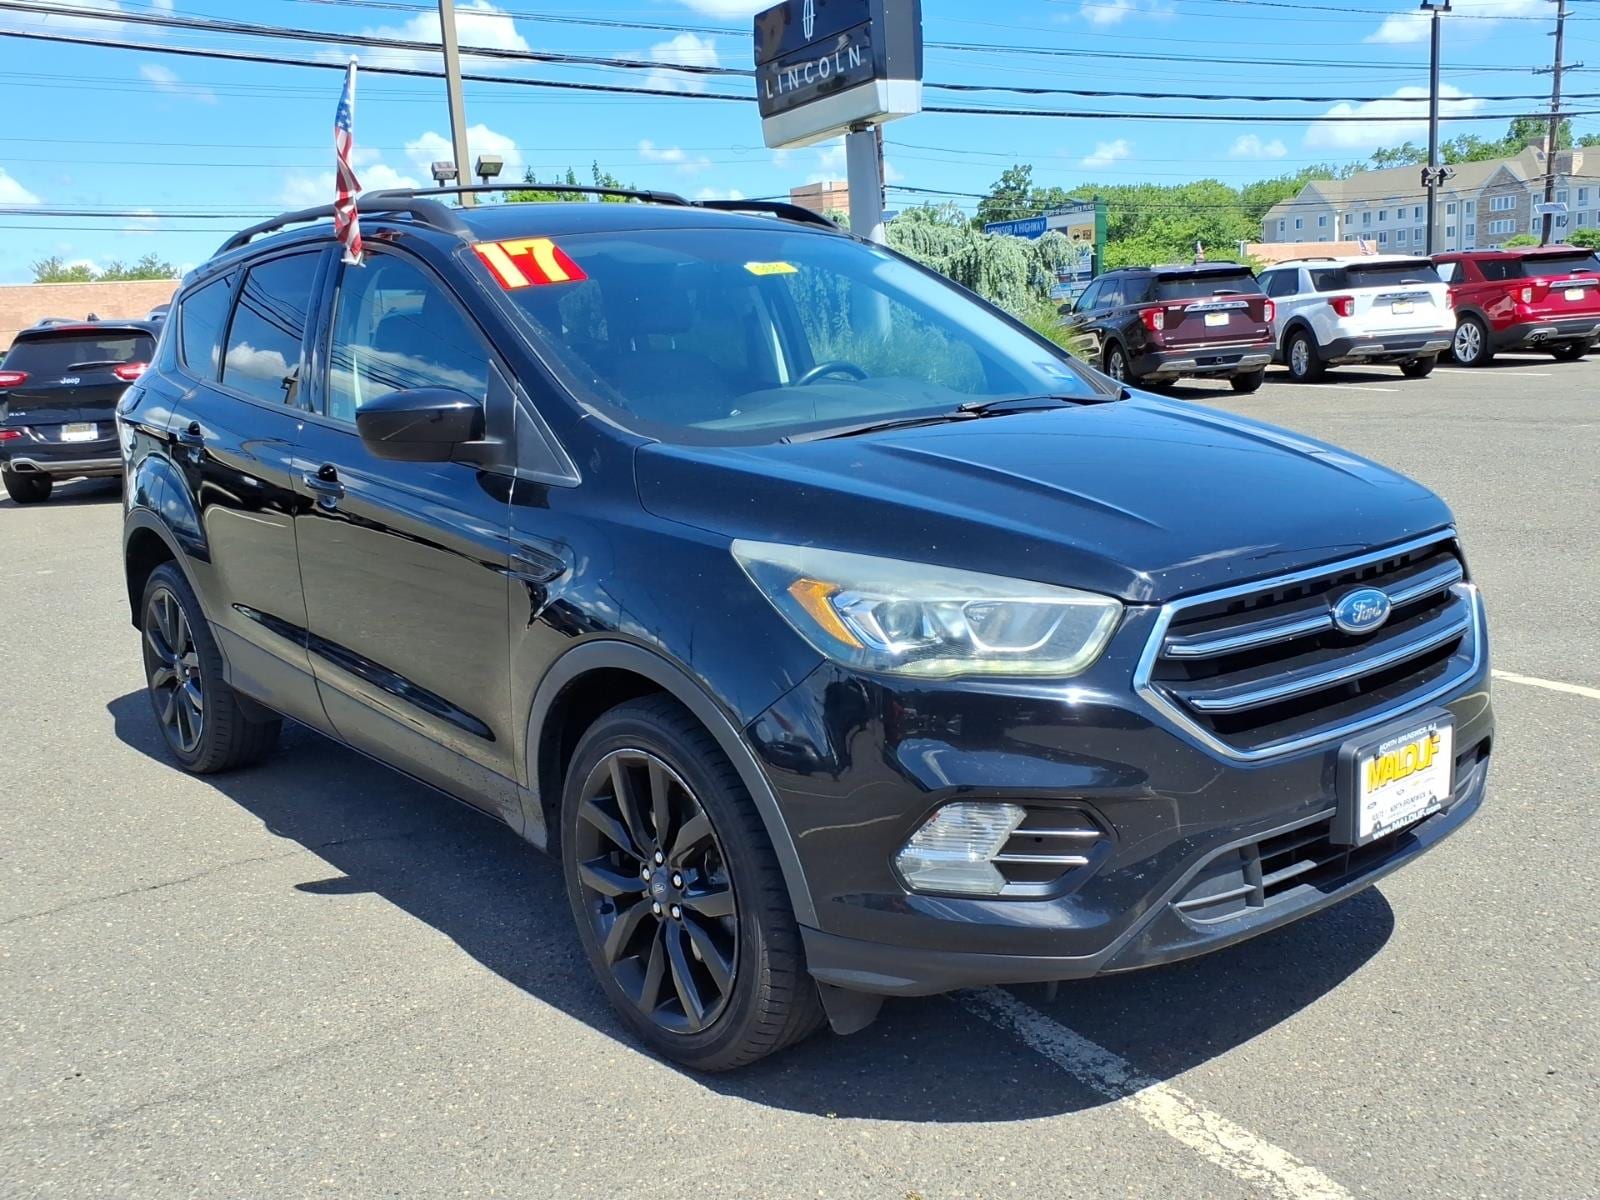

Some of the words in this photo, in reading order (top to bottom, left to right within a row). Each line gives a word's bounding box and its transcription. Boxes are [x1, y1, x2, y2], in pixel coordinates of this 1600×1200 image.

[765, 44, 862, 99] LINCOLN
[1018, 220, 1045, 233] HIGHWAY
[472, 237, 570, 289] 17
[60, 377, 81, 385] Jeep
[1352, 598, 1382, 623] Ford
[1367, 734, 1441, 794] MALOUF
